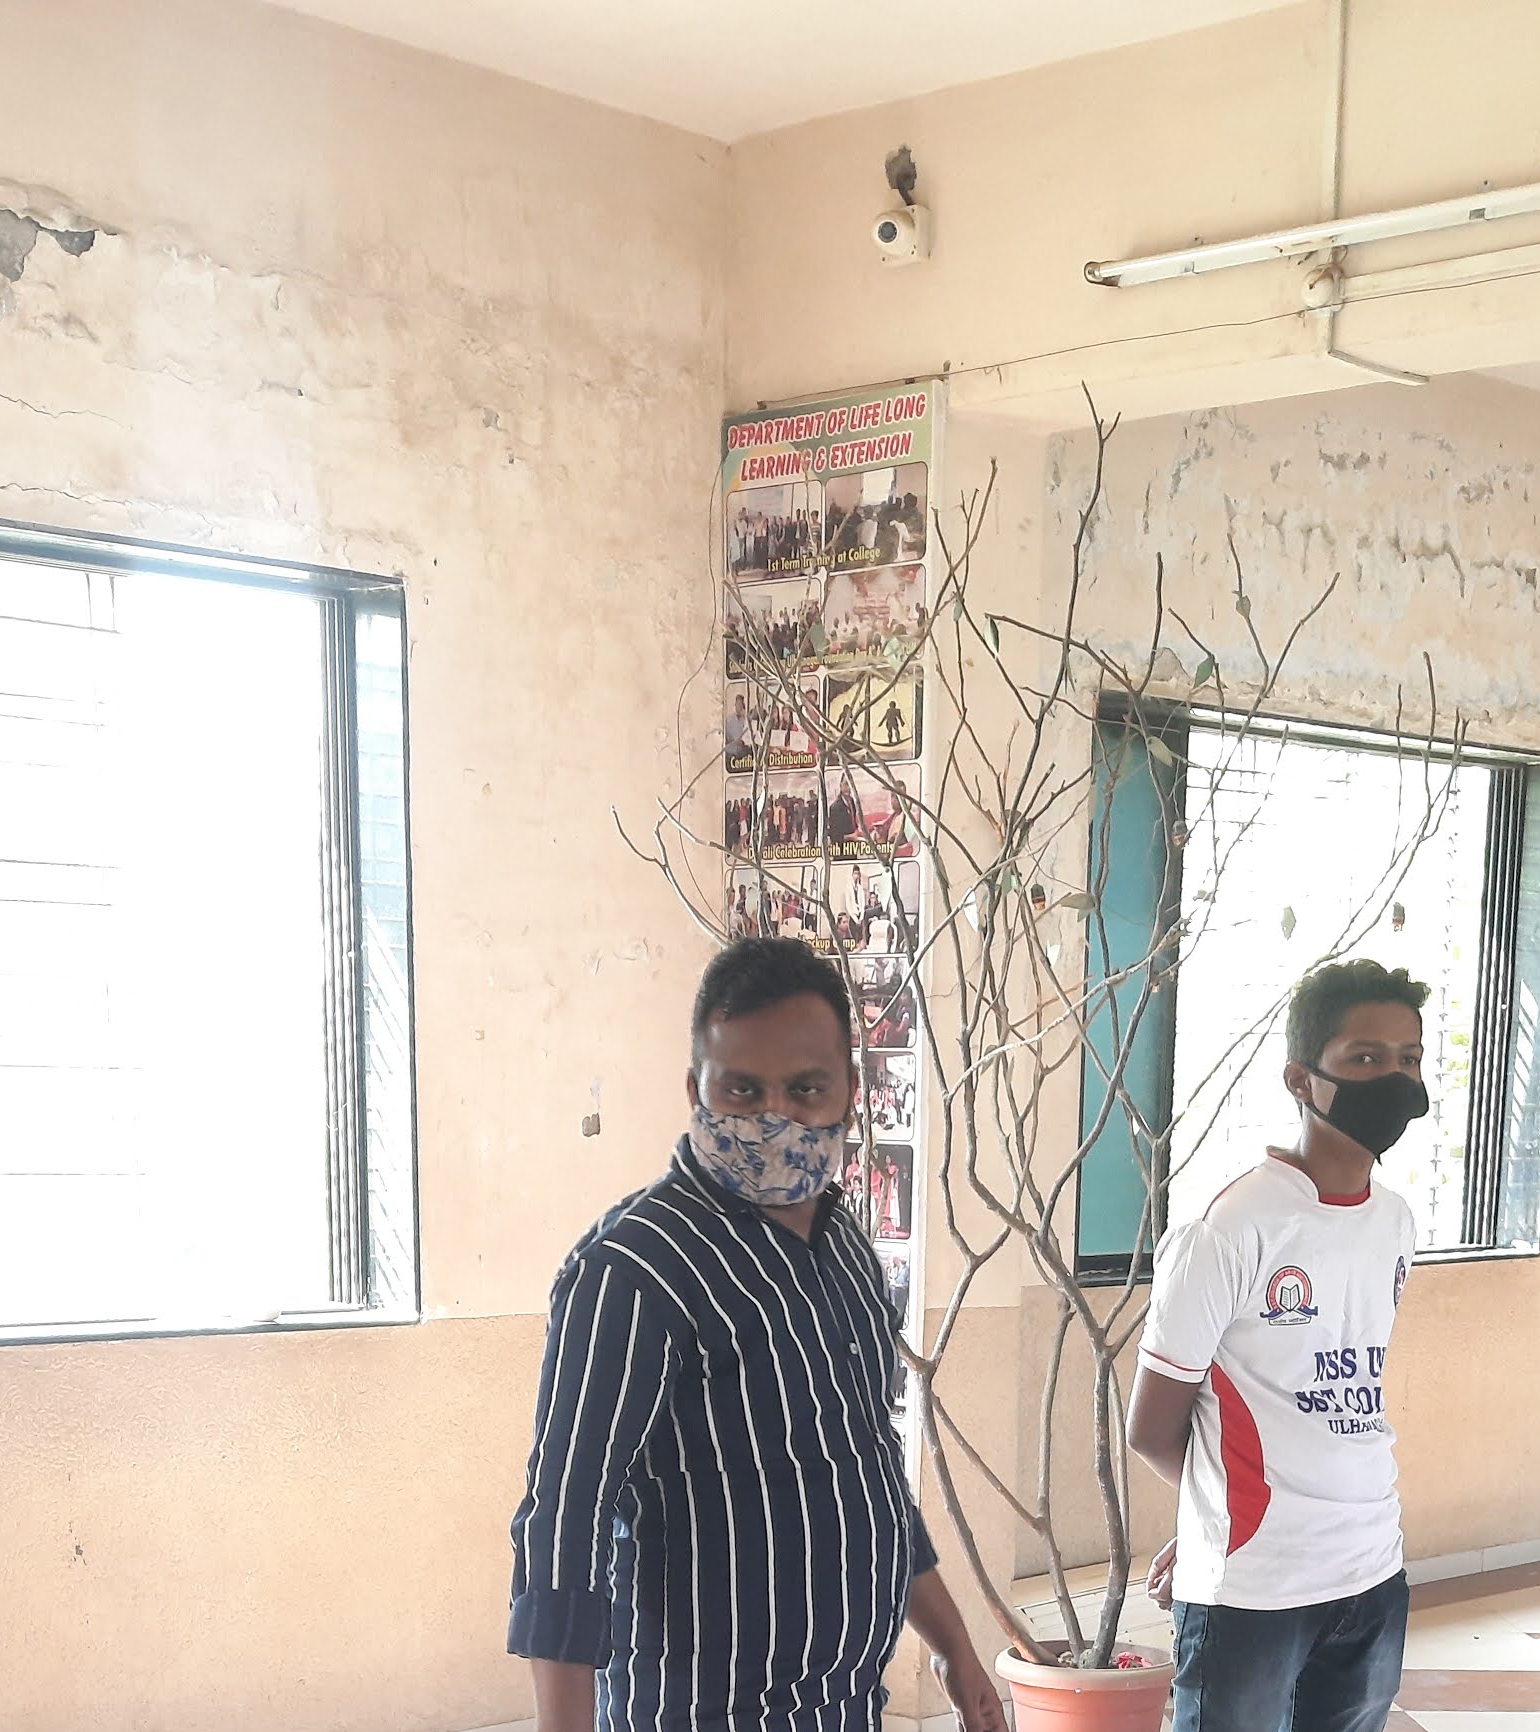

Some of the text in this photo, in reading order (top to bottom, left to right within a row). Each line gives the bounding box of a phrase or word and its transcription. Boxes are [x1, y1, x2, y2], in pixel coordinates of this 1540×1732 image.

[728, 394, 927, 449] DEPARTMENT OF LIFE LONG
[741, 431, 912, 482] LEARNING & EXTENSION
[767, 558, 779, 572] 1st
[781, 556, 801, 571] Term
[838, 550, 847, 564] at
[848, 546, 881, 564] College
[769, 752, 813, 766] Distribution
[748, 845, 773, 860] Dali
[775, 843, 821, 860] Celebration
[825, 842, 841, 857] ith
[843, 841, 858, 857] HIV
[1313, 1347, 1357, 1382] NSS
[1295, 1388, 1343, 1414] SST
